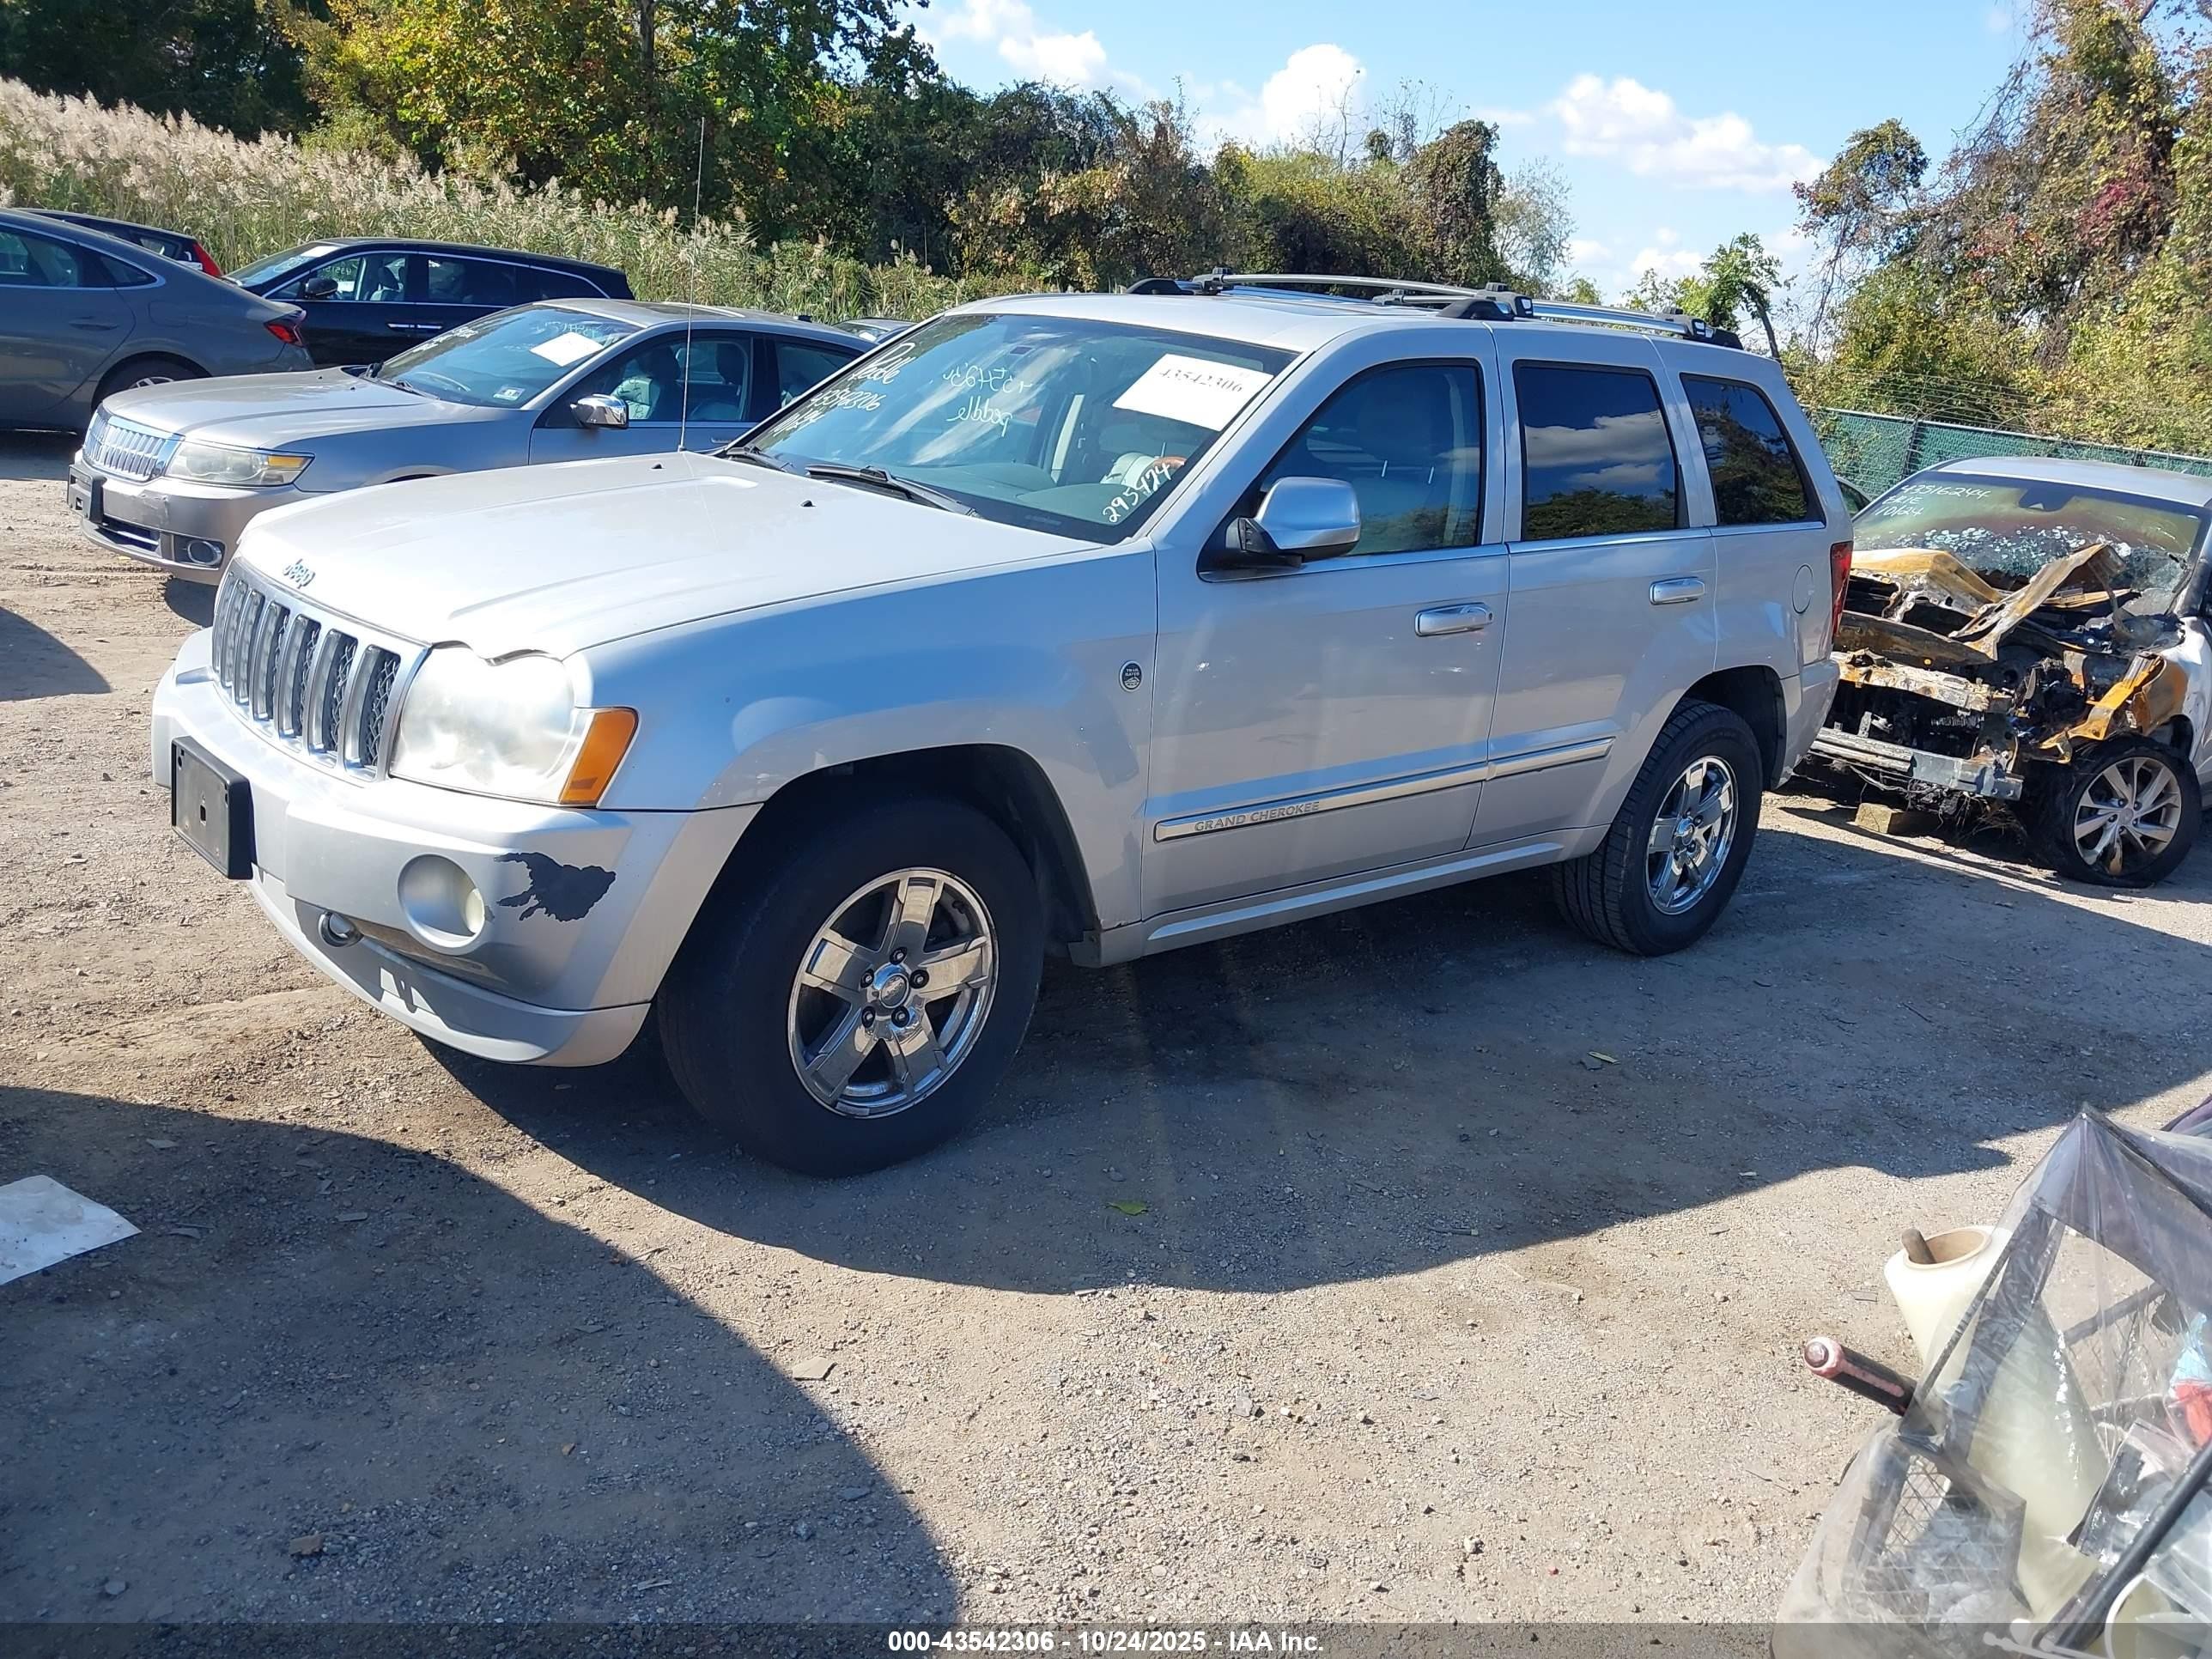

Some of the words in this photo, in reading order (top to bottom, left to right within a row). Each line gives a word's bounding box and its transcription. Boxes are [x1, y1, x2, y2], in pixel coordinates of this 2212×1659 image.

[1900, 484, 1992, 500] 43516244
[1875, 504, 1924, 517] 10/24
[283, 558, 316, 590] Jeep
[1194, 814, 1247, 832] GRAND
[1249, 801, 1320, 822] CHEROKEE
